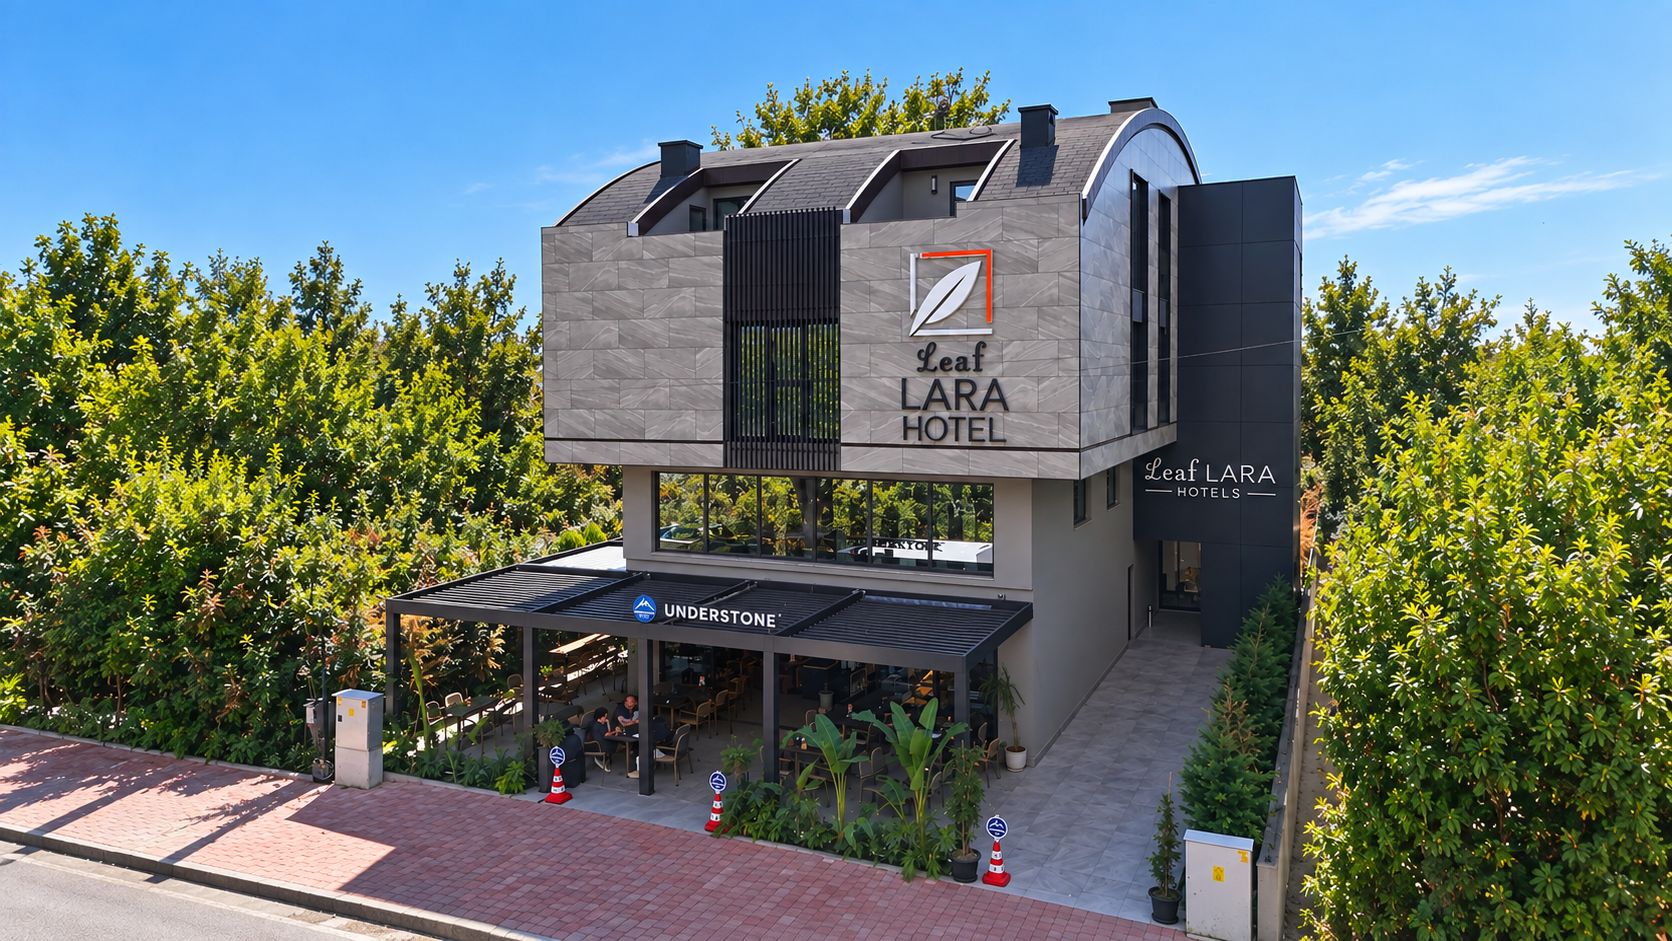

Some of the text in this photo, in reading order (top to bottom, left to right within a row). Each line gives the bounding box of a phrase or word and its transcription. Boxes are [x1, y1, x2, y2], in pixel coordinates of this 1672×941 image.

[917, 341, 987, 372] Leaf
[901, 378, 1009, 412] LARA
[903, 416, 1007, 442] HOTEL
[1145, 457, 1276, 484] Leaf LARA
[1177, 486, 1241, 499] HOTELS
[664, 603, 776, 628] UNDERSTONE
